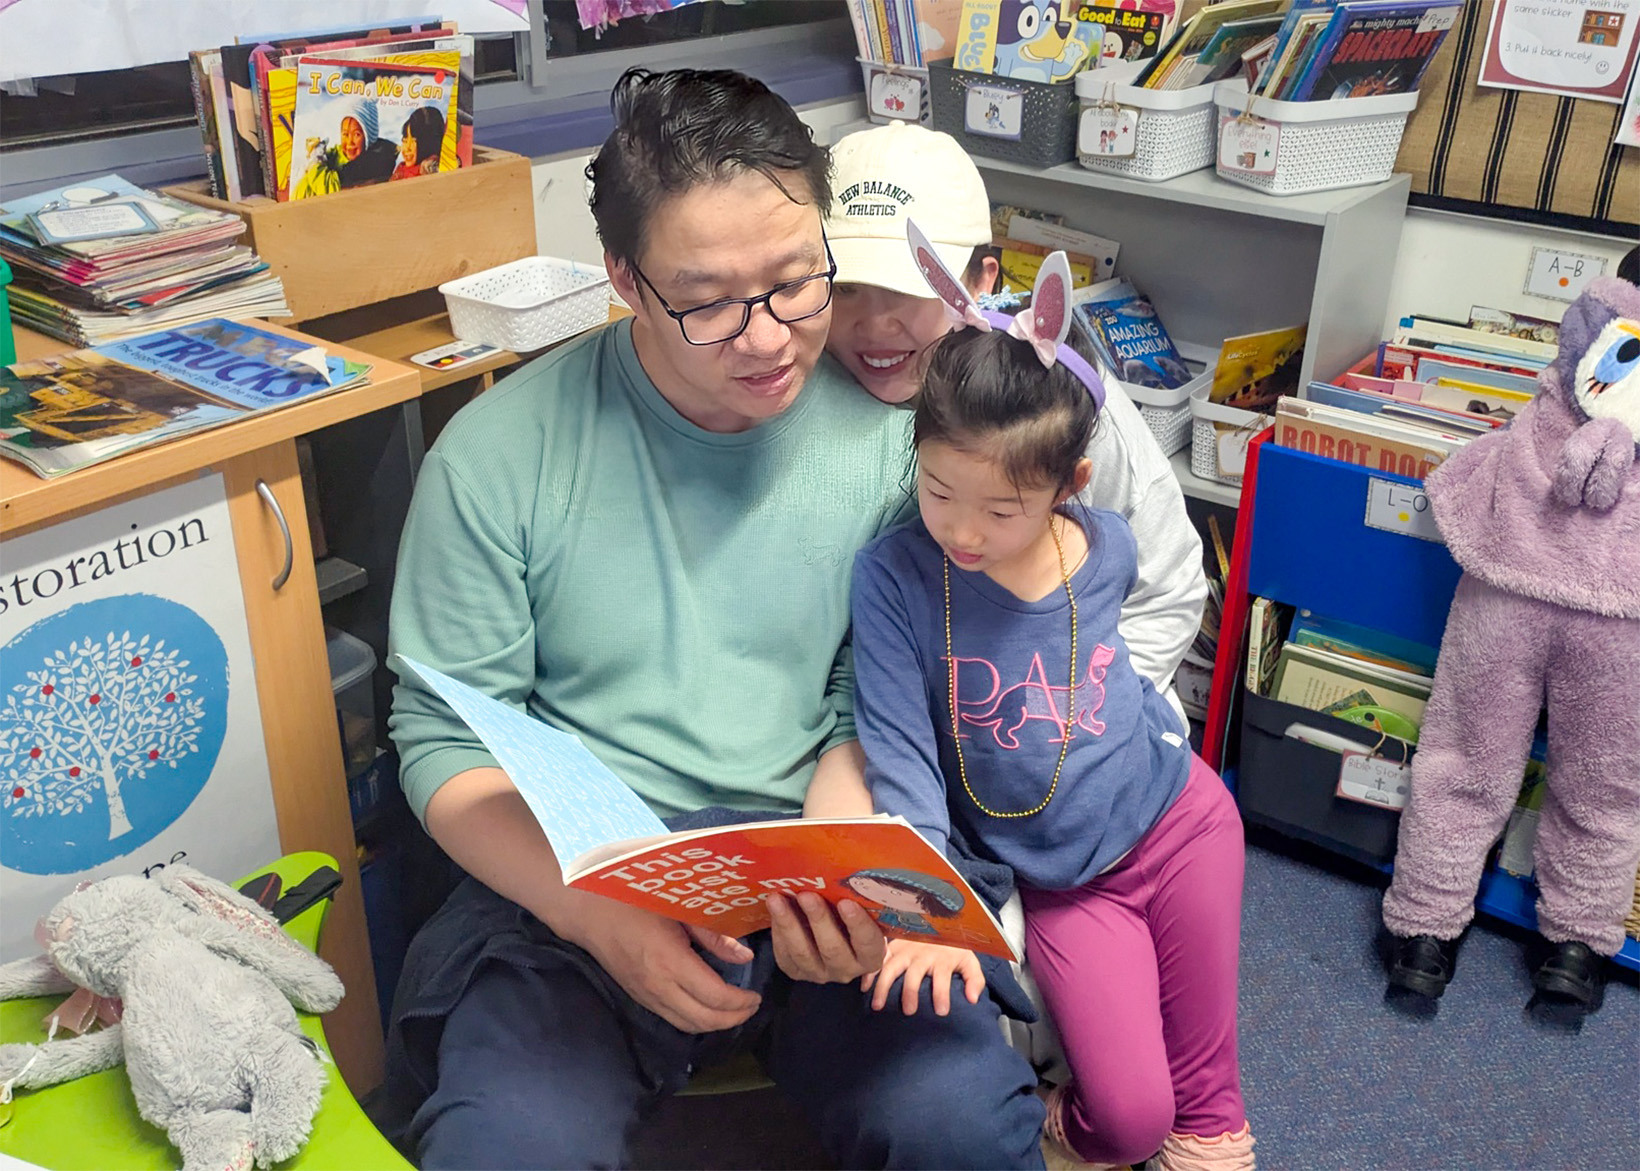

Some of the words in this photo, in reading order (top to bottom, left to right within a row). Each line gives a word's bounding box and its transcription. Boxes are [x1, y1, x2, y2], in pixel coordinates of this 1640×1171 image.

[1079, 7, 1116, 24] Good
[1115, 17, 1122, 26] to
[1122, 12, 1147, 29] Eat
[1364, 16, 1396, 30] mighty
[1514, 5, 1539, 15] same
[1541, 8, 1574, 18] sticker
[1515, 44, 1529, 54] Put
[1541, 46, 1562, 57] back
[308, 72, 322, 95] I
[326, 71, 371, 97] Can,
[375, 75, 404, 98] We
[408, 78, 443, 100] Can
[380, 98, 388, 107] by
[388, 98, 400, 106] Don
[838, 183, 860, 205] NEW
[863, 181, 913, 206] BALANCE
[846, 204, 896, 216] ATHLETICS
[1108, 321, 1160, 344] AMAZING
[1115, 337, 1172, 361] AQUARIUM
[137, 331, 308, 398] TRUCKS
[1282, 425, 1372, 468] ROBOT
[1348, 758, 1371, 773] Bible
[599, 848, 714, 881] This
[627, 854, 756, 894] book
[652, 870, 748, 905] just
[681, 885, 751, 910] ate
[758, 876, 827, 890] my
